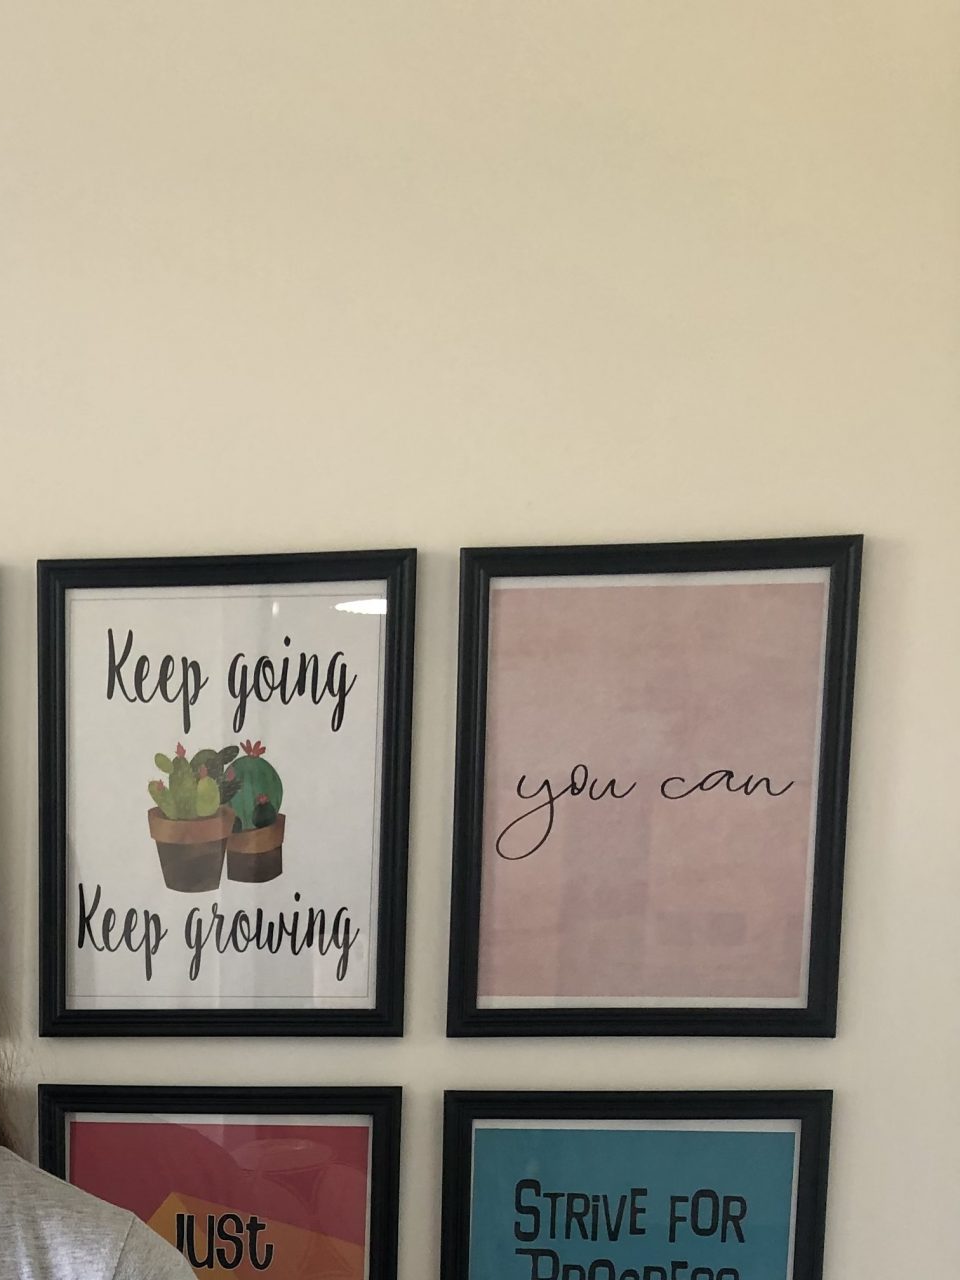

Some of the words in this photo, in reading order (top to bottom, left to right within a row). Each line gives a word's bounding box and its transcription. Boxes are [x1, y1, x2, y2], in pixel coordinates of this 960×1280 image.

[106, 627, 209, 735] Keep
[227, 635, 358, 734] going
[495, 763, 637, 861] you
[660, 769, 795, 800] can
[77, 882, 168, 982] Keep
[184, 891, 361, 982] growing
[668, 1188, 748, 1243] FOR
